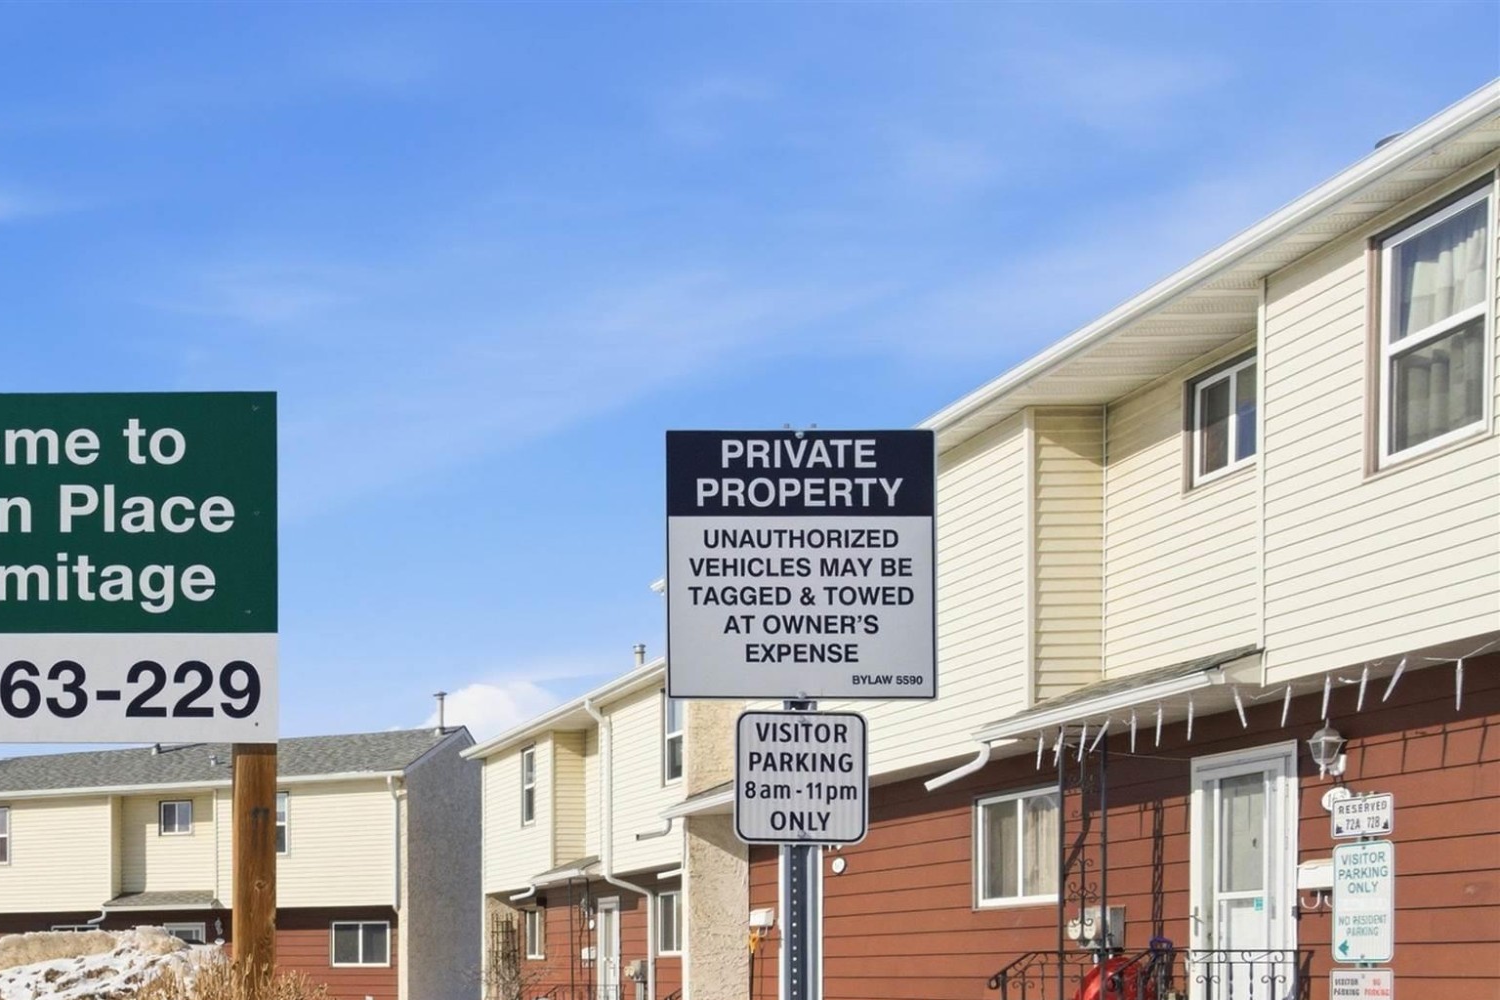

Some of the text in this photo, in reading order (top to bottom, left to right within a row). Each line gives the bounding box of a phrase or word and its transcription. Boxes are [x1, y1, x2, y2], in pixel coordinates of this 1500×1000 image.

[123, 418, 186, 465] to
[721, 439, 877, 468] PRIVATE
[696, 477, 903, 507] PROPERTY
[59, 484, 235, 533] Place
[703, 529, 899, 549] UNAUTHORIZED
[689, 557, 913, 577] VEHICLES MAY BE
[688, 586, 915, 606] TAGGED & TOWED
[723, 614, 880, 635] AT OWNER'S
[745, 643, 859, 663] EXPENSE
[852, 675, 924, 686] BYLAW 5590
[756, 722, 848, 744] VISITOR
[749, 751, 854, 773] PARKING
[1339, 801, 1386, 814] RESERVED
[770, 810, 831, 831] ONLY
[1346, 819, 1360, 830] 72A
[1342, 852, 1384, 865] VISITOR
[1339, 867, 1387, 880] PARKING
[1349, 882, 1378, 894] ONLY
[1339, 915, 1386, 926] NO RESIDENT
[1347, 927, 1378, 936] PARKING
[1334, 988, 1359, 996] PARKING
[1335, 978, 1358, 986] VISITOR
